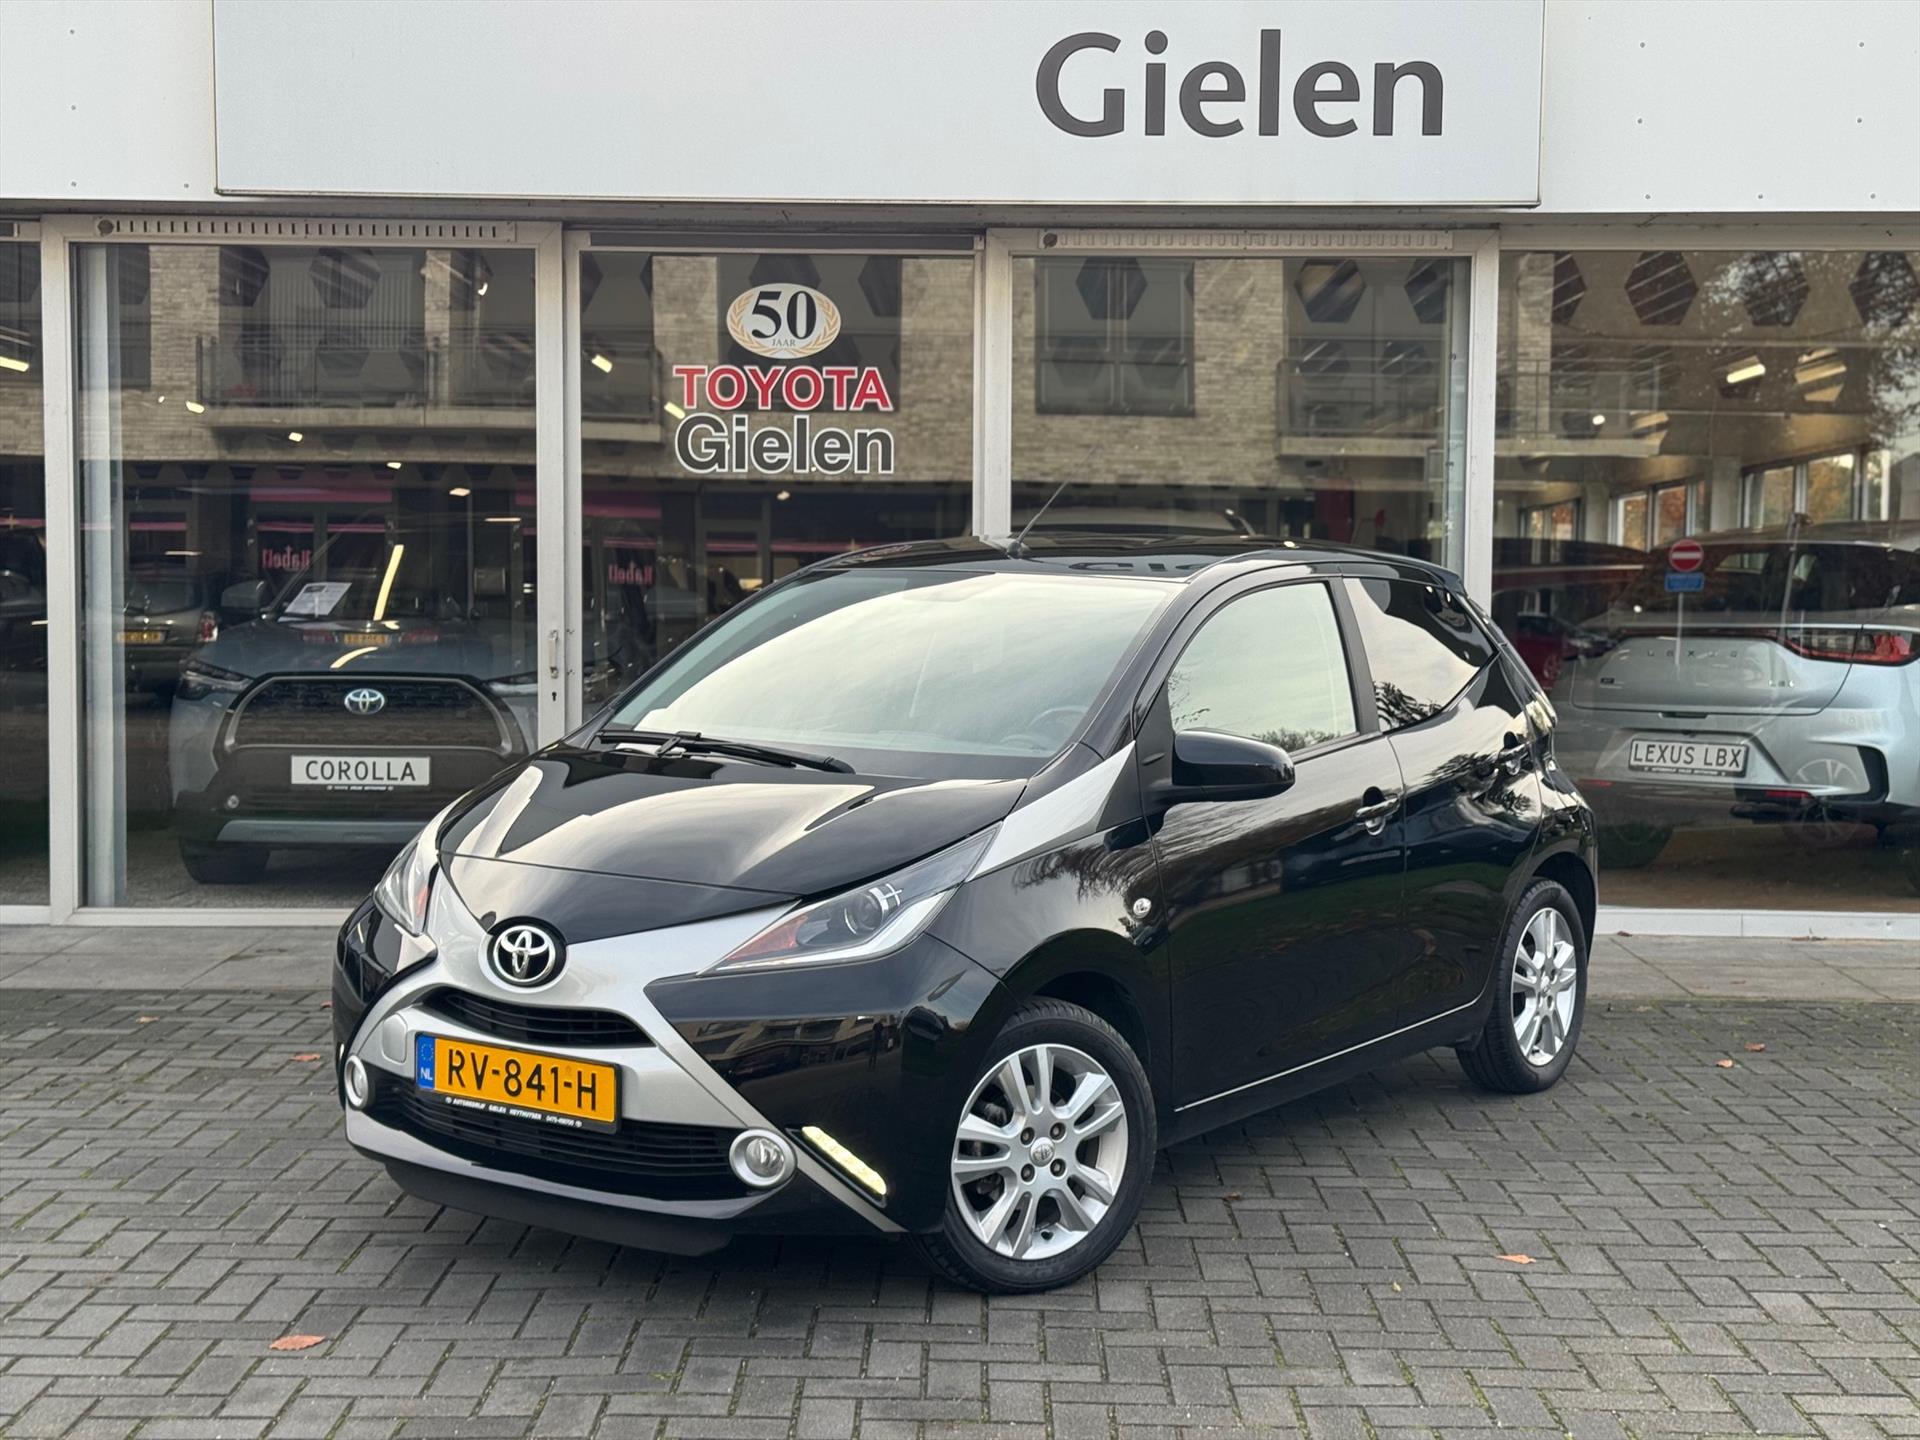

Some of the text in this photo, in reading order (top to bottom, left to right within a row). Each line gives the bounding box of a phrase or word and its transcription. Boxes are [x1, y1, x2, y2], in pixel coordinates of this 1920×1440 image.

[1036, 29, 1444, 138] Gielen
[751, 290, 817, 339] 50
[771, 338, 796, 347] JAAR
[673, 365, 894, 411] TOYOTA
[675, 412, 894, 474] Gielen
[305, 760, 416, 781] COROLLA
[1633, 744, 1742, 768] LEXUS LBX
[420, 1067, 433, 1081] NL
[448, 1048, 597, 1111] RV-841-H
